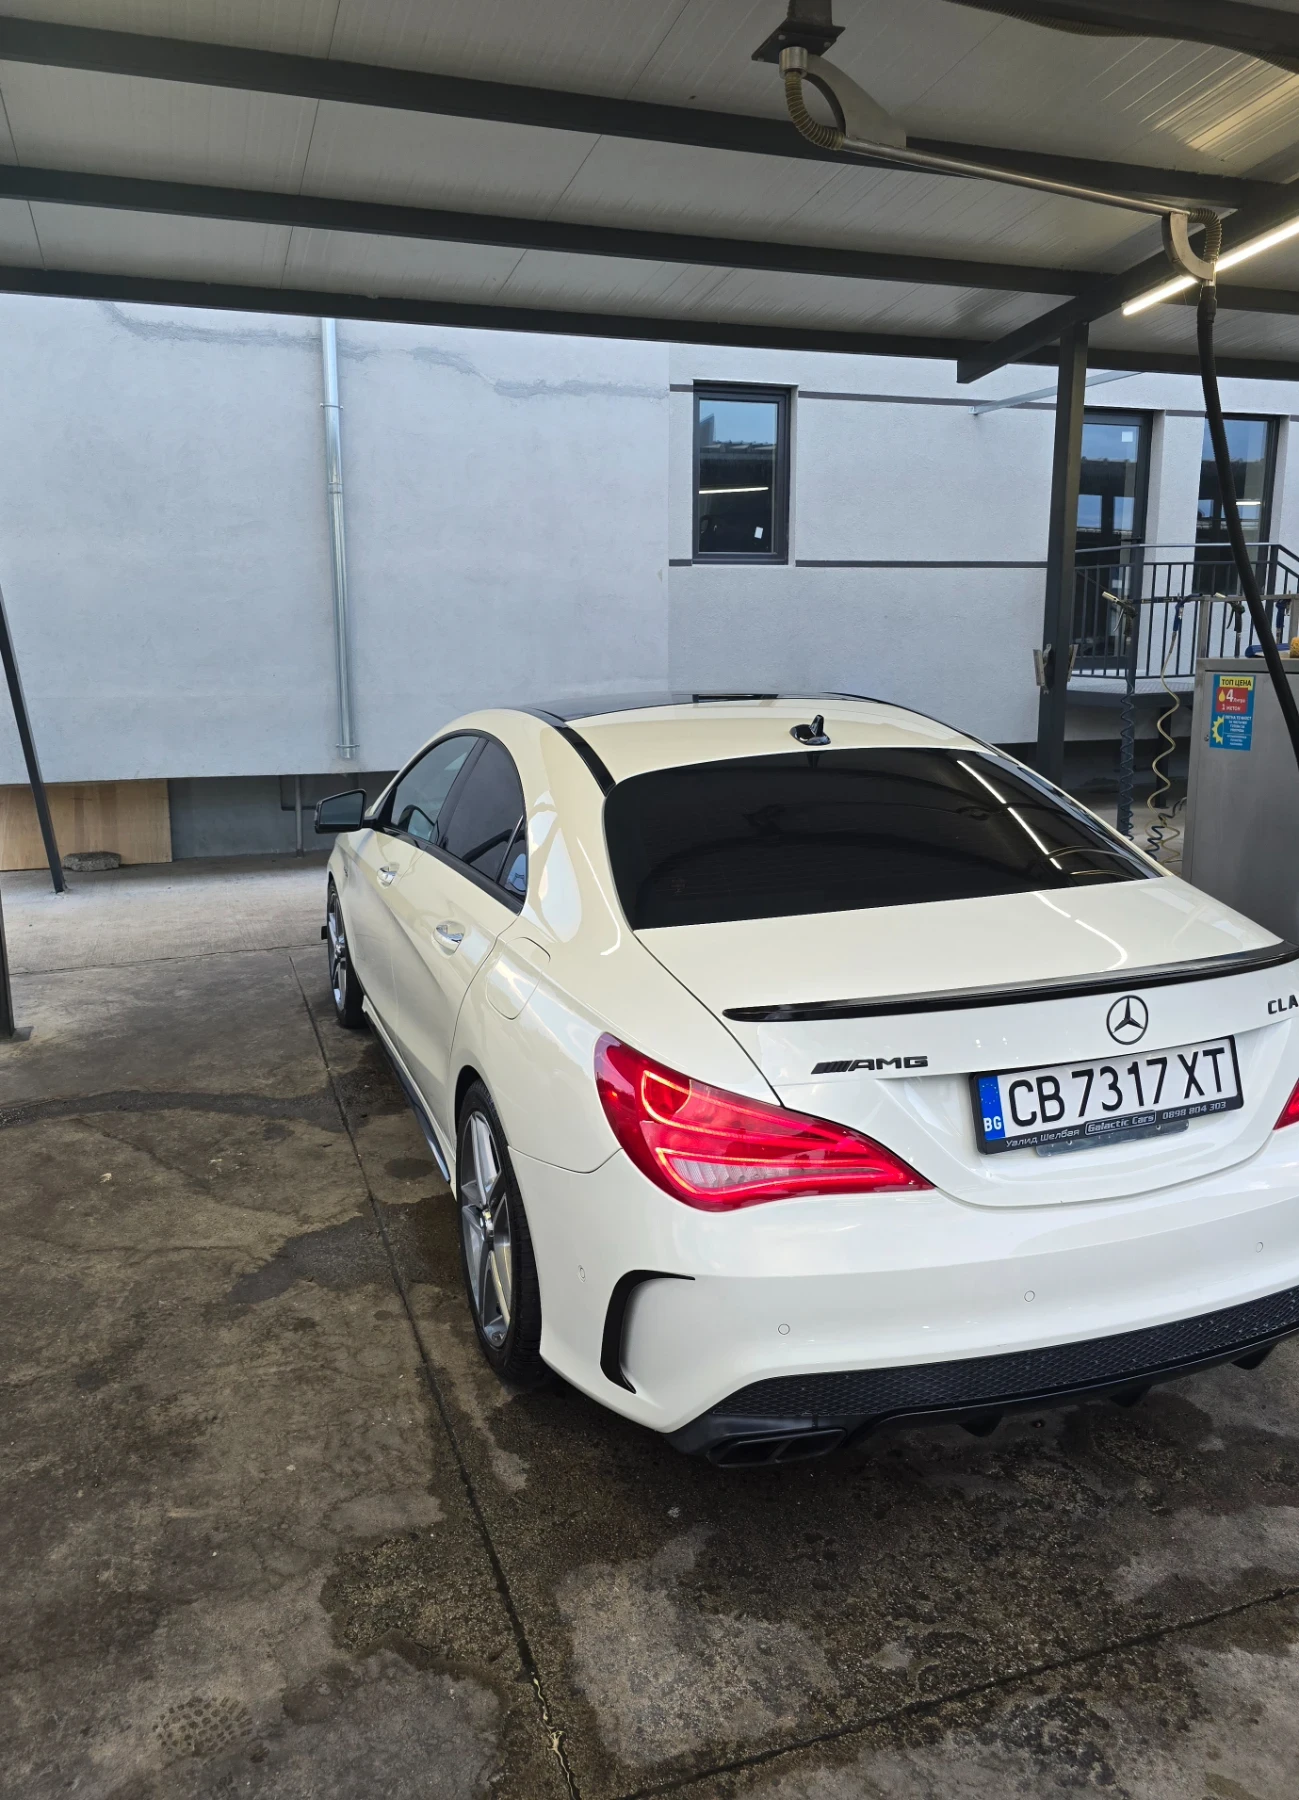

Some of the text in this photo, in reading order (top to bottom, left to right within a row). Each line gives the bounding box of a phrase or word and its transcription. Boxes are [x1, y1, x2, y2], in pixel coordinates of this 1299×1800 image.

[1226, 688, 1234, 703] 4
[1267, 994, 1299, 1015] CLA
[847, 1055, 928, 1072] AMG
[1008, 1046, 1225, 1127] CB 7317 XT
[1162, 1101, 1227, 1120] 0898 804 303
[983, 1115, 1002, 1132] BG
[1088, 1114, 1155, 1133] Galactic Cars
